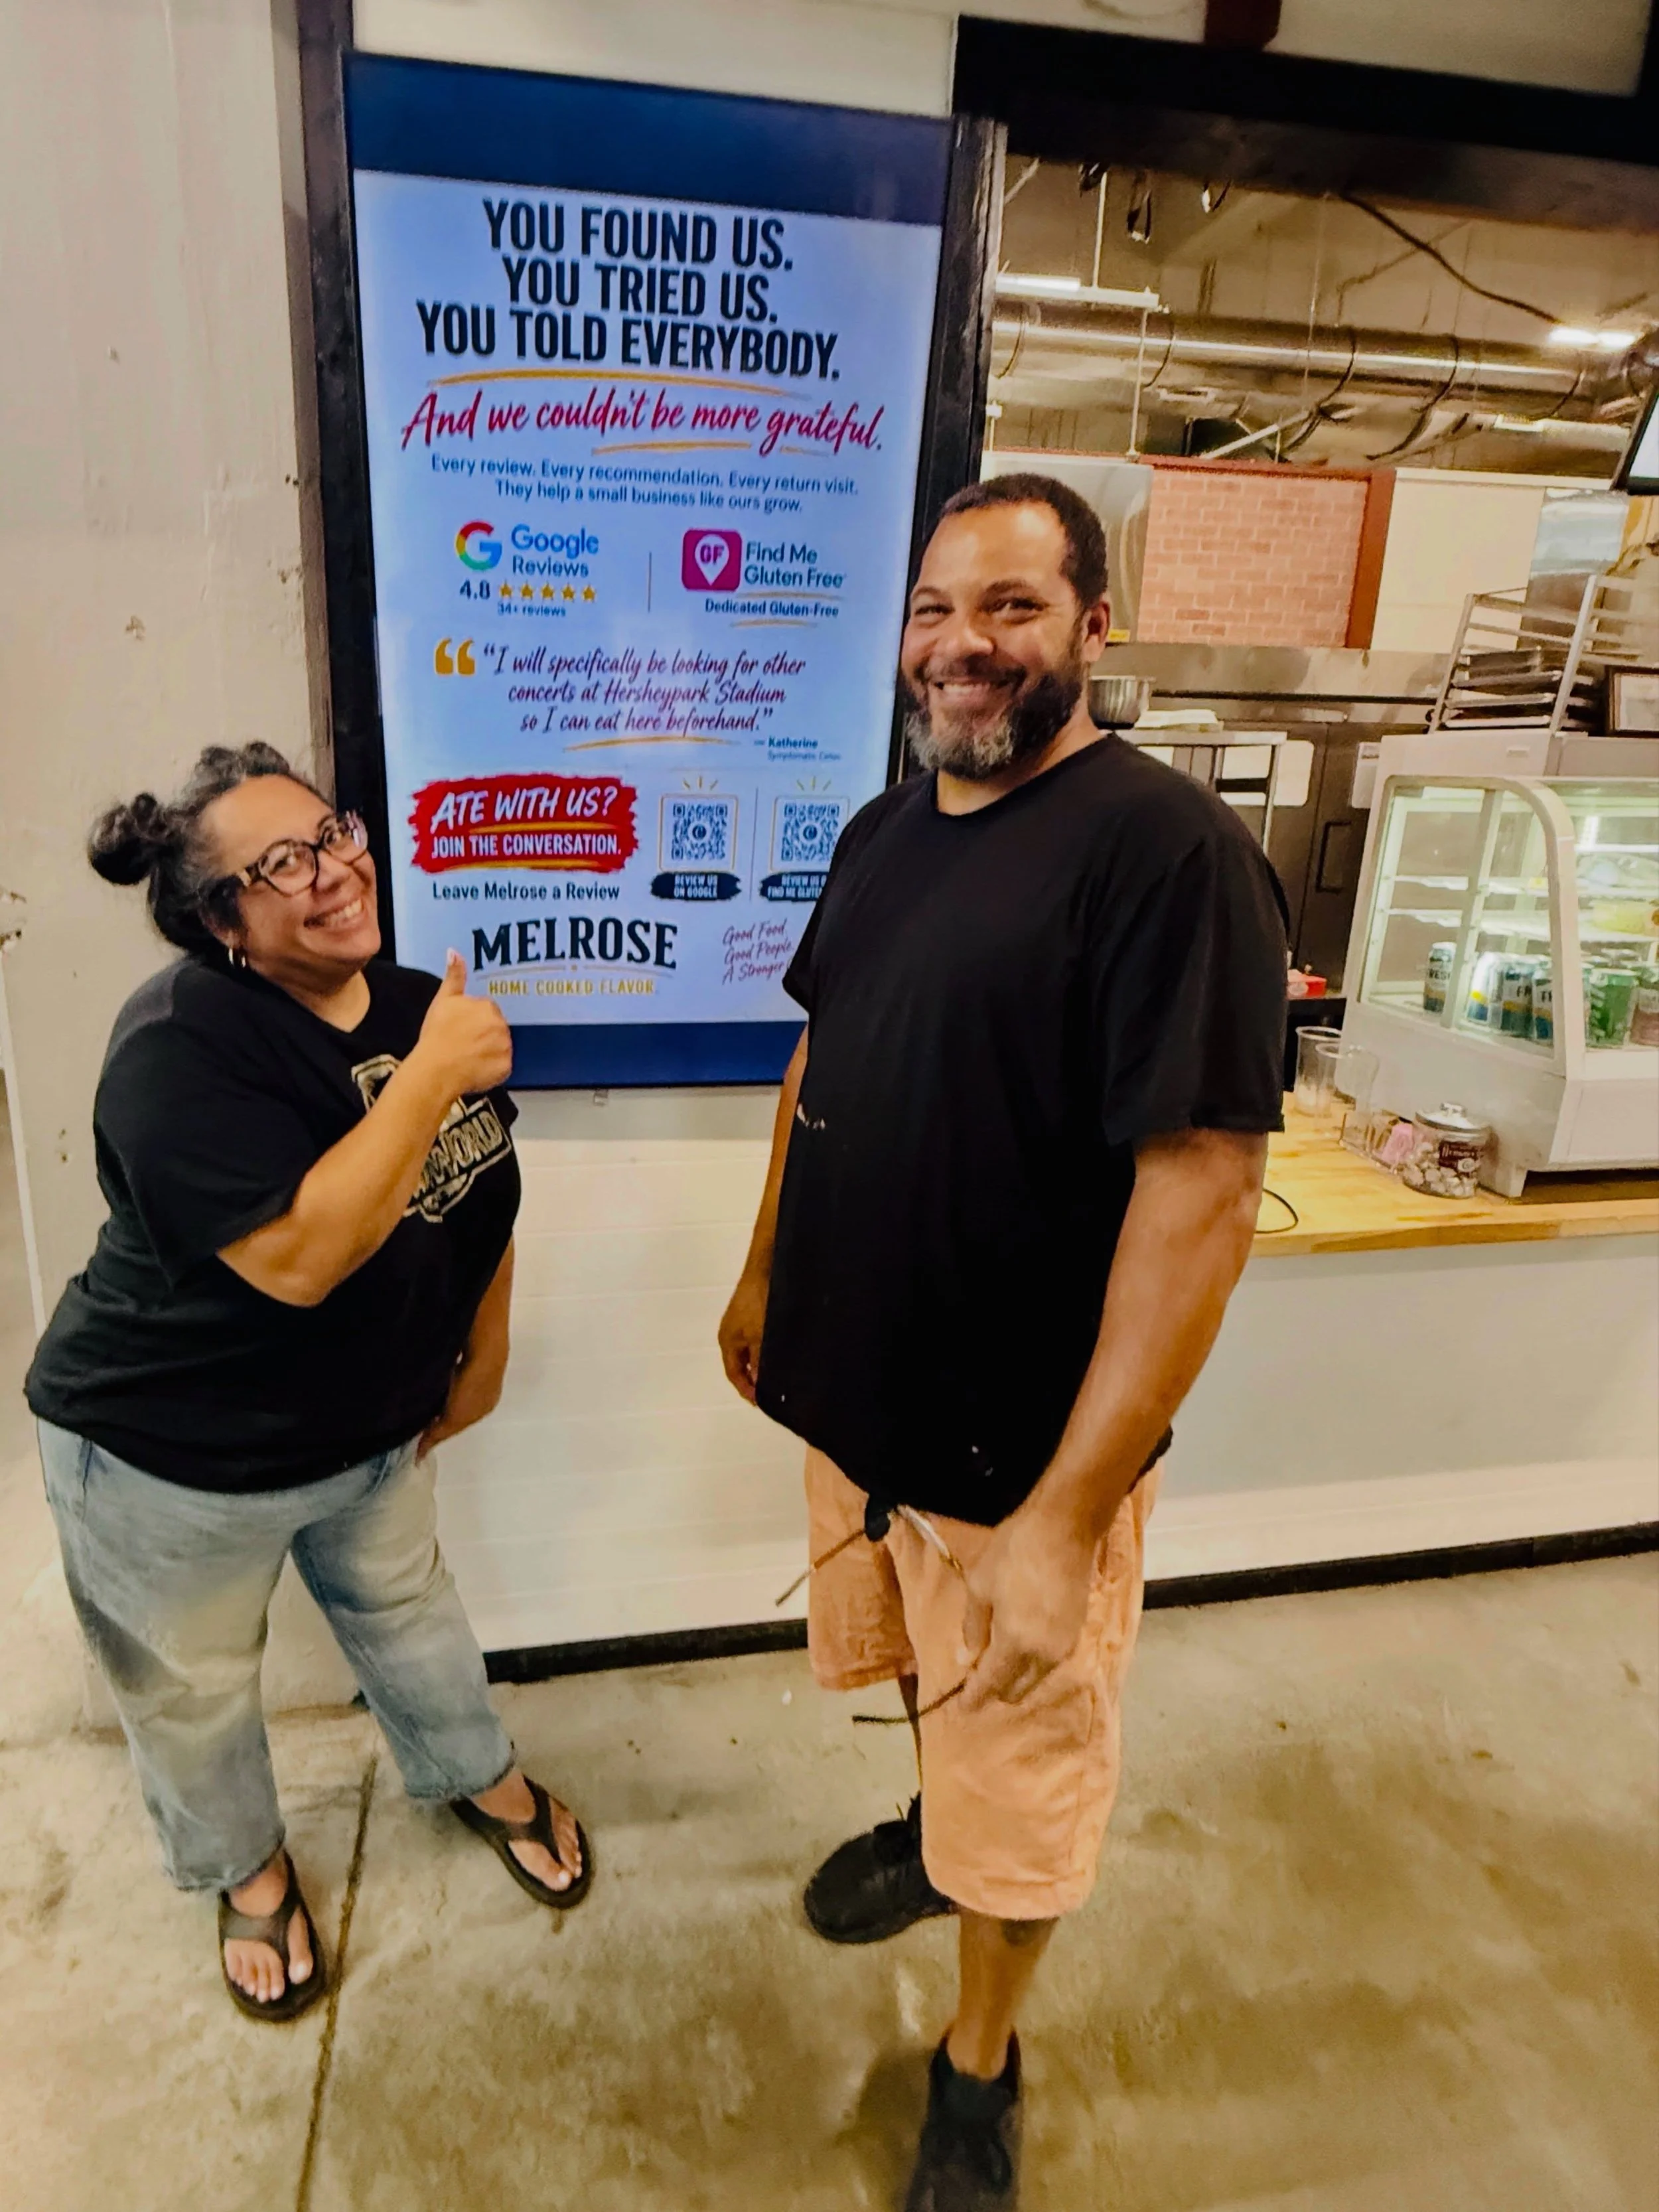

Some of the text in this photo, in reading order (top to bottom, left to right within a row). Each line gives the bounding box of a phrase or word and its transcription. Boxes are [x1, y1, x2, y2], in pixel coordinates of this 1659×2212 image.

[482, 196, 794, 271] YOU FOUND US.
[502, 253, 778, 324] YOU TRIED US.
[415, 297, 841, 380] YOU TOLD EVERYBODY.
[401, 386, 885, 458] And we couldn't be more grateful.
[431, 452, 859, 495] Every review. Every recommendation. Every return visit.
[496, 479, 803, 514] They help a small business like ours grow.
[455, 520, 502, 571] G
[511, 523, 599, 559] Google
[745, 540, 818, 564] Find Me
[512, 555, 589, 578] Reviews
[699, 544, 725, 565] GF
[744, 564, 843, 589] Gluten Free
[459, 579, 490, 600] 4.8
[522, 603, 566, 617] reviews
[705, 597, 839, 619] Dedicated Gluten-Free
[512, 645, 547, 674] will
[547, 646, 642, 684] specifically
[646, 648, 667, 674] be
[672, 648, 729, 684] looking
[731, 649, 759, 682] for
[762, 650, 806, 676] other
[508, 678, 786, 713] concerts at Hersheypark Stadium
[520, 713, 538, 731] so
[542, 705, 558, 733] I
[559, 713, 591, 731] can
[595, 708, 622, 732] eat
[624, 707, 662, 731] here
[768, 735, 818, 749] Katherine
[429, 785, 618, 834] ATE WITH US?
[431, 834, 622, 859] JOIN THE CONVERSATION.
[432, 880, 620, 901] Leave Melrose a Review
[674, 874, 717, 886] REVIEW US
[674, 885, 717, 898] ON GOOGLE
[781, 875, 809, 886] REVIEW
[472, 916, 678, 972] MELROSE
[723, 922, 756, 945] Good
[724, 944, 755, 965] Good
[722, 964, 734, 985] A
[738, 962, 784, 982] Stronger
[488, 980, 530, 995] HOME
[536, 980, 594, 995] COOKED
